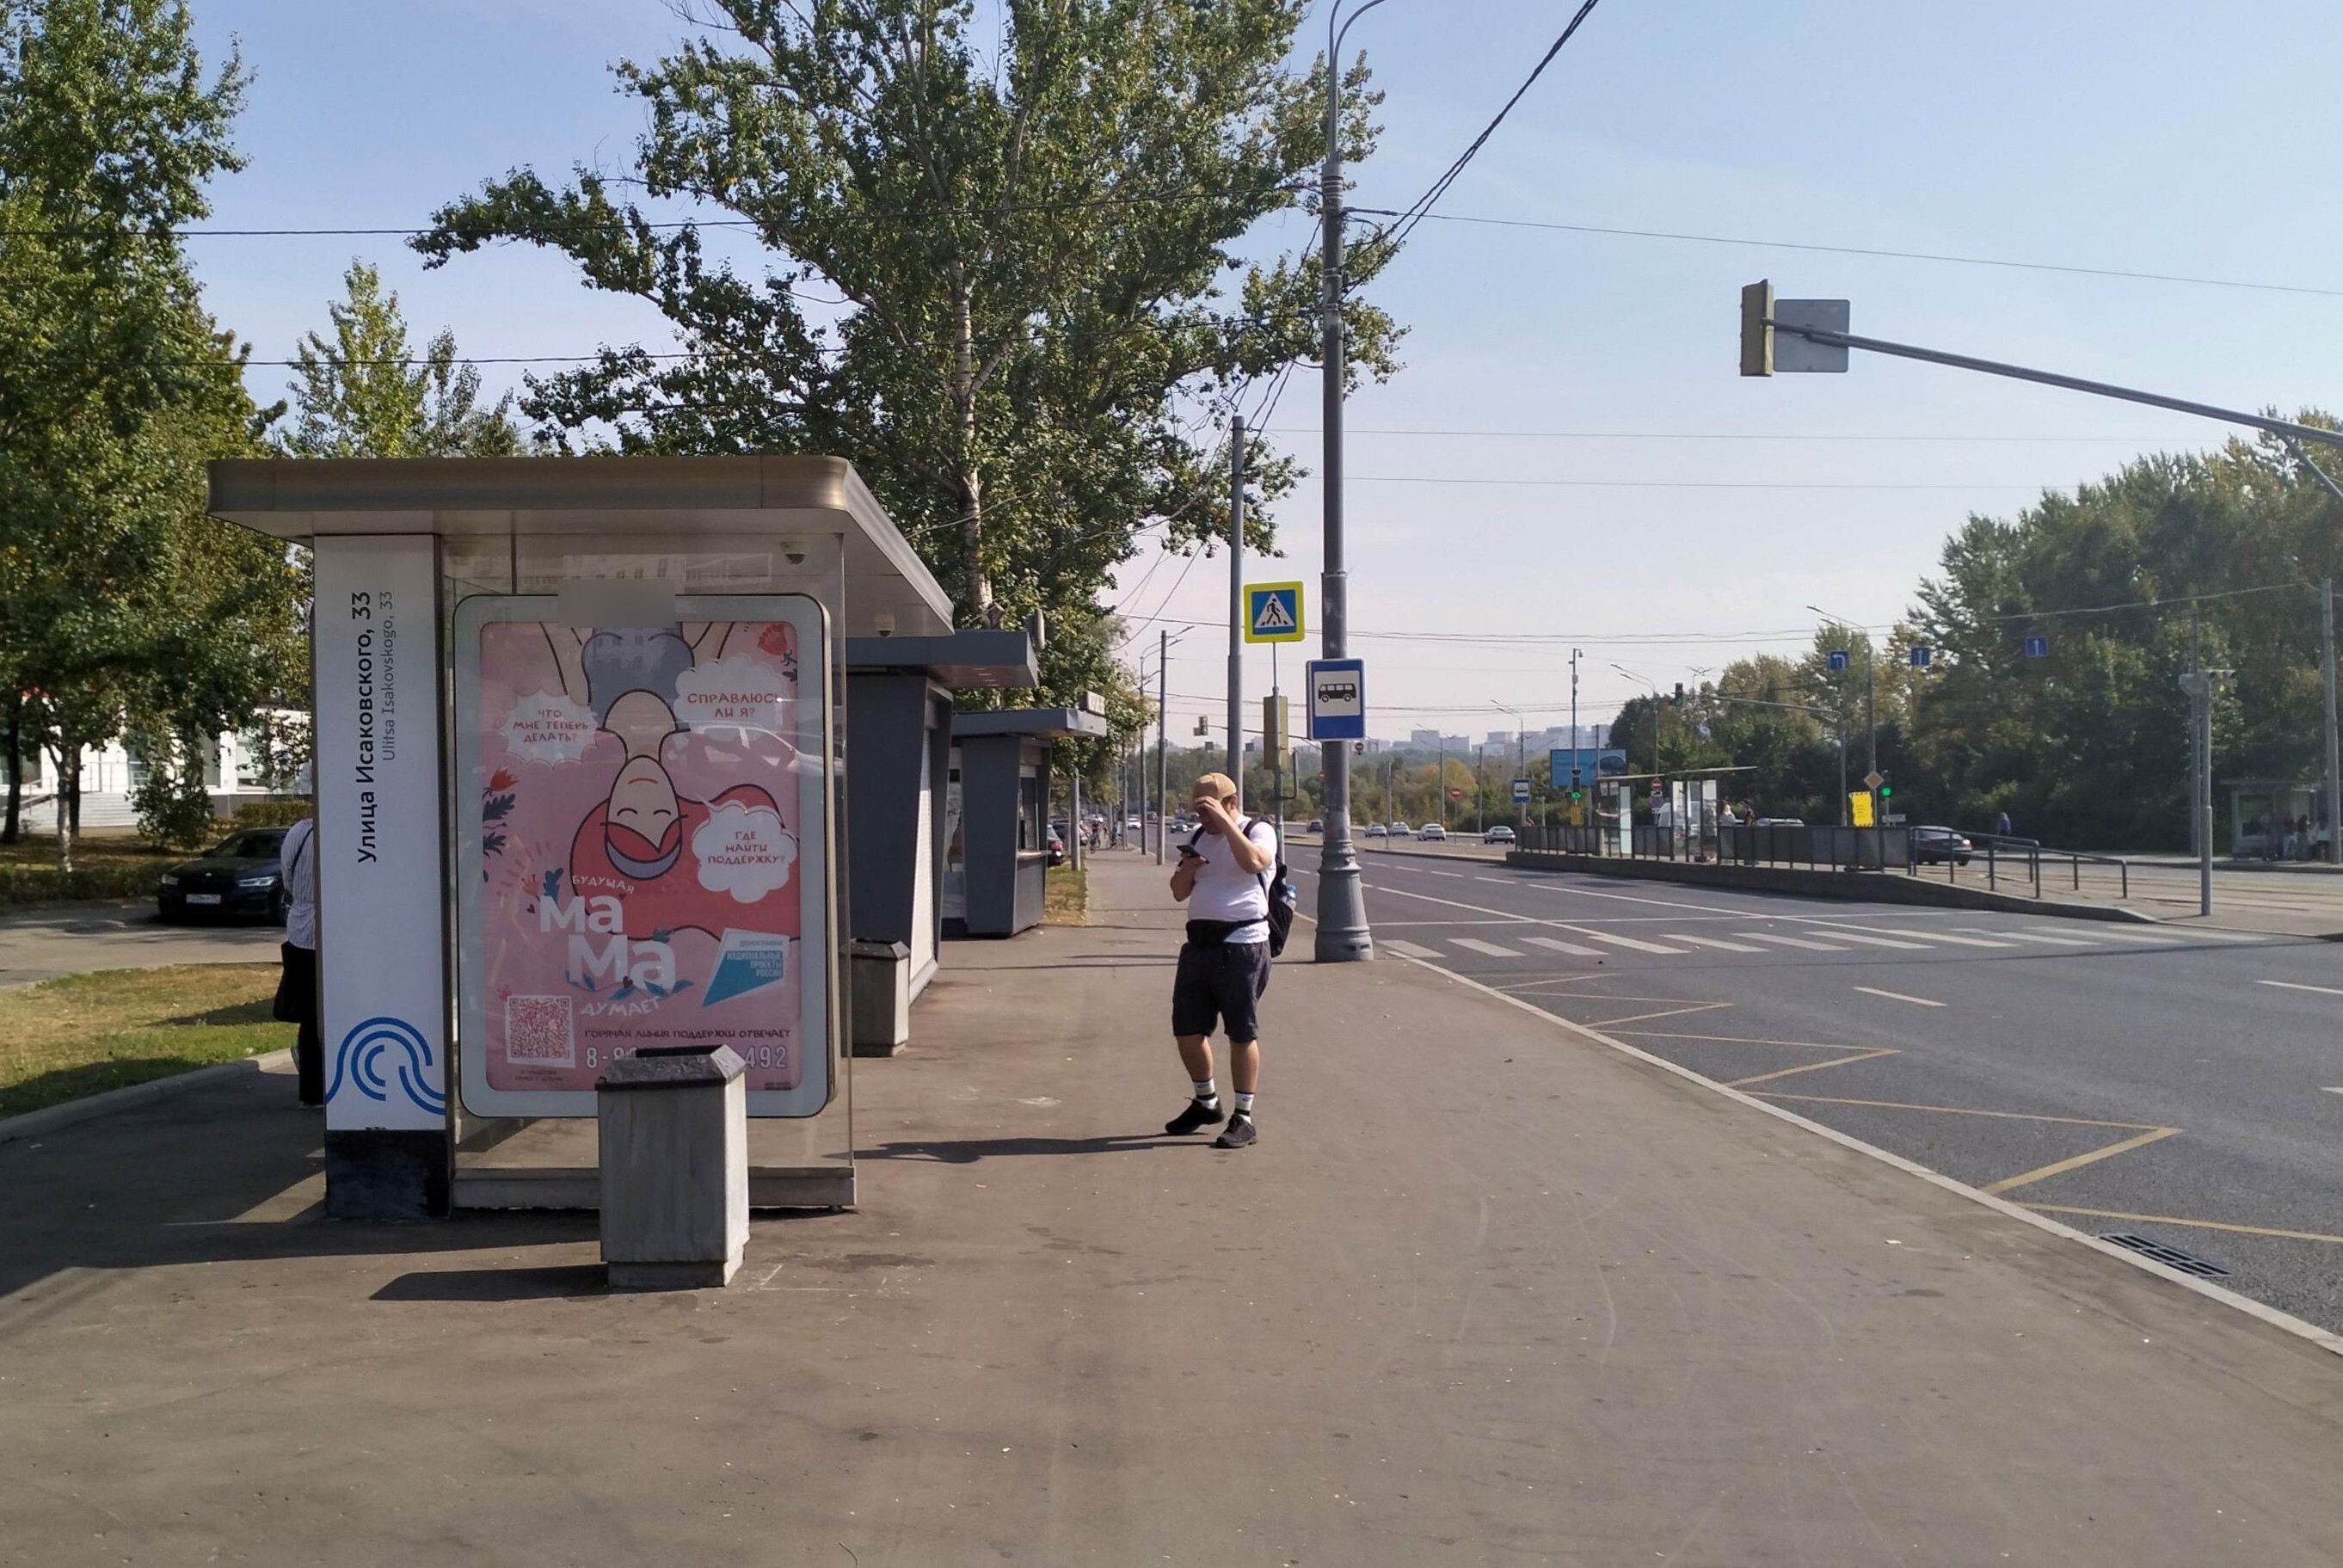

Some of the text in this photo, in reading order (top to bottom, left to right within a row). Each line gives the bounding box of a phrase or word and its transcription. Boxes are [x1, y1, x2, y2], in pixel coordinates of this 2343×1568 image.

[379, 591, 397, 761] Ulitsa Isakovskogo, 33
[538, 709, 563, 718] ЧТО
[715, 707, 755, 718] ЛИ Я?
[351, 591, 378, 864] Улица Исаковского, 33
[513, 721, 588, 730] МНЕ ТЕПЕРЬ
[523, 732, 578, 743] ДЕЛАТЬ?
[735, 831, 757, 841] ГДЕ
[708, 855, 785, 865] ПОДДЕРЖКУ?
[572, 875, 635, 895] БУДУЩАЯ
[581, 996, 661, 1018] ДУМАЕТ
[585, 1029, 790, 1039] ГОРЯЧАЯ ЛИНИЯ ПОДДЕРЖКИ ОТВЕЧАЕТ
